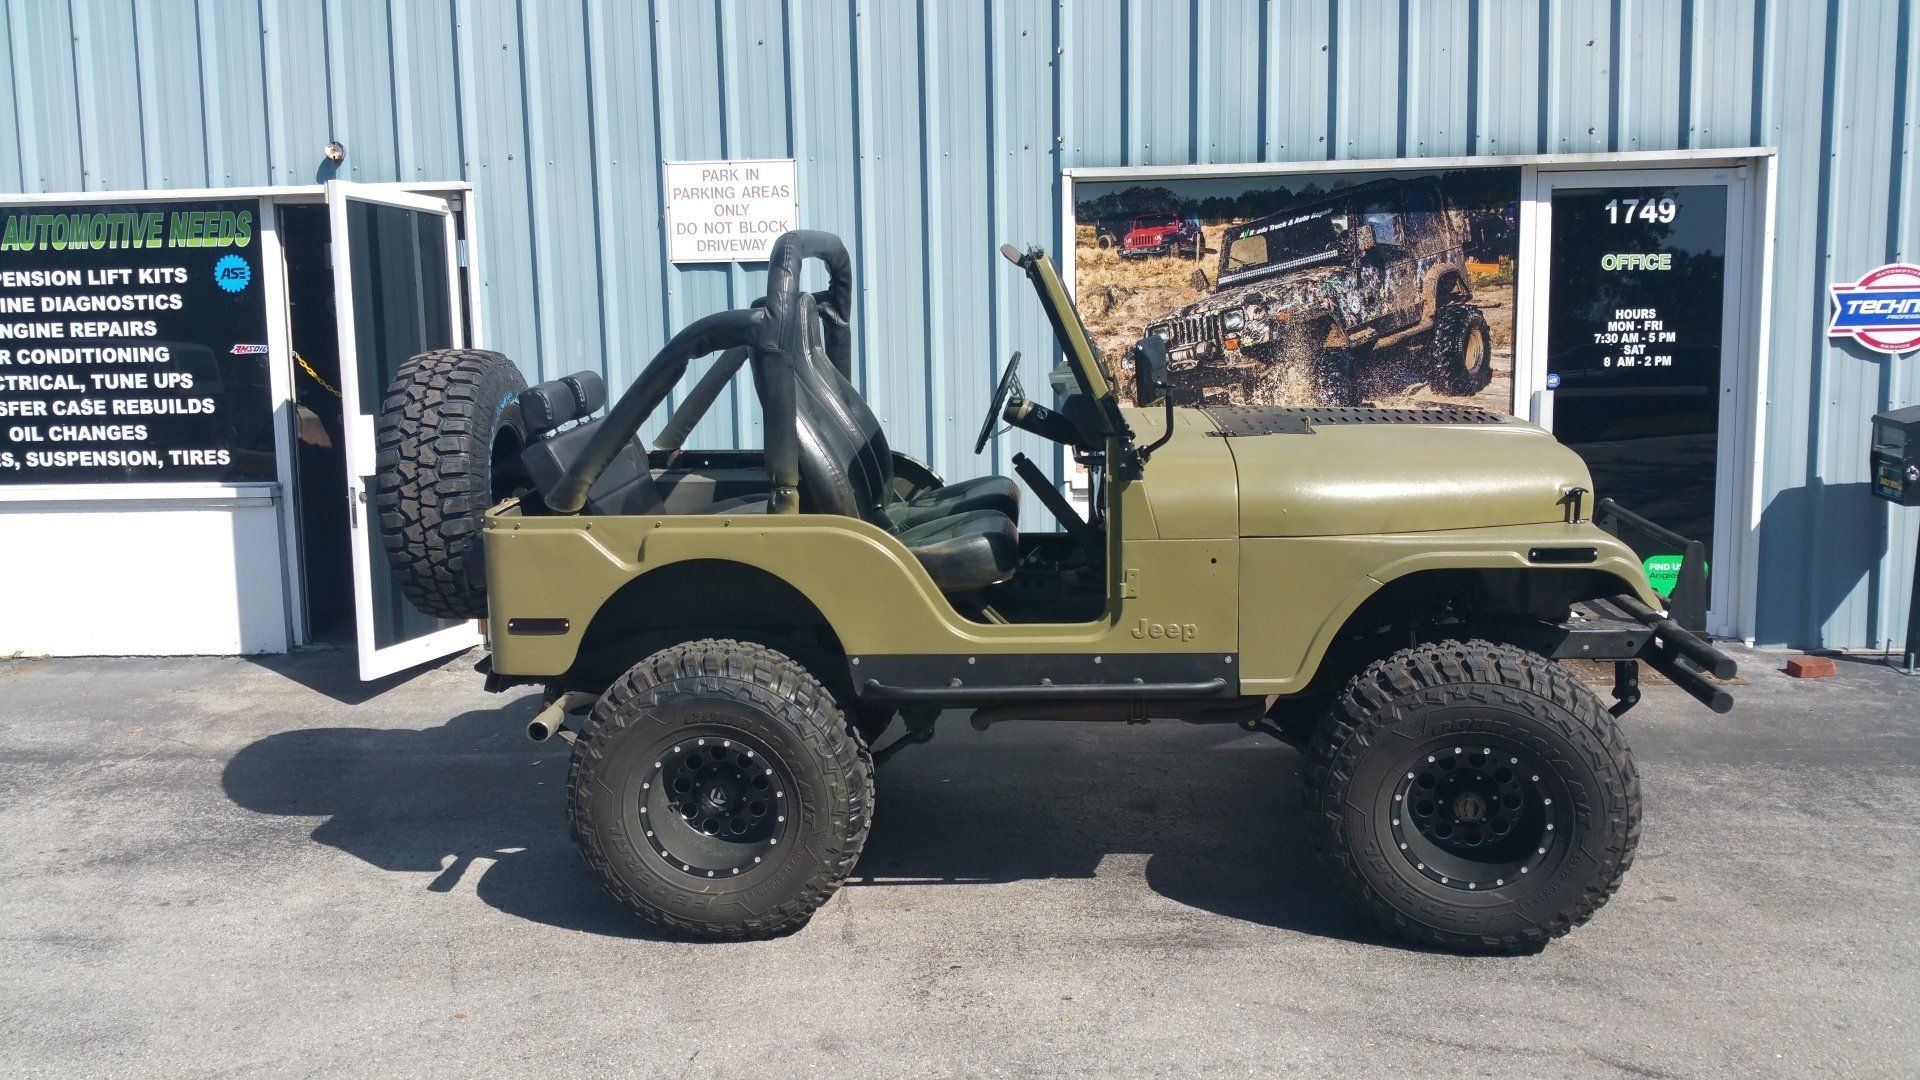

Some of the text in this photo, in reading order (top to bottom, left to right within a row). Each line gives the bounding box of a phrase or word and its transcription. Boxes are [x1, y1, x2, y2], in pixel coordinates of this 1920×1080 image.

[702, 168, 759, 181] PARK IN
[673, 185, 790, 200] PARKING AREAS
[714, 203, 750, 217] ONLY
[1605, 197, 1676, 224] 1749
[1, 210, 252, 251] AUTOMOTIVE NEEDS
[676, 220, 788, 235] DO NOT BLOCK
[696, 239, 768, 252] DRIVEWAY
[1601, 254, 1672, 271] OFFICE
[0, 268, 188, 287] ENSION LIFT KITS
[221, 266, 246, 280] ASE
[41, 294, 182, 312] DIAGNOSTICS
[1615, 309, 1656, 320] HOURS
[70, 320, 157, 338] REPAIRS
[1608, 321, 1634, 332] MON
[1644, 321, 1663, 331] FRI
[1594, 333, 1618, 344] 7:30
[1621, 333, 1639, 343] AM
[1649, 333, 1656, 343] 5
[1659, 332, 1676, 342] PM
[17, 347, 170, 365] CONDITIONING
[234, 345, 268, 353] AMSOIL
[1623, 344, 1646, 355] SAT
[1603, 357, 1611, 367] 8
[1617, 356, 1635, 366] AM
[1644, 356, 1652, 366] 2
[1655, 356, 1672, 366] PM
[91, 374, 148, 389] TUNE
[154, 373, 194, 389] UPS
[52, 400, 107, 416] CASE
[113, 398, 215, 415] REBUILDS
[9, 425, 148, 442] OIL CHANGES
[26, 451, 163, 469] SUSPENSION,
[169, 450, 231, 466] TIRES
[1649, 572, 1680, 580] Angie
[1131, 619, 1198, 642] Jeep
